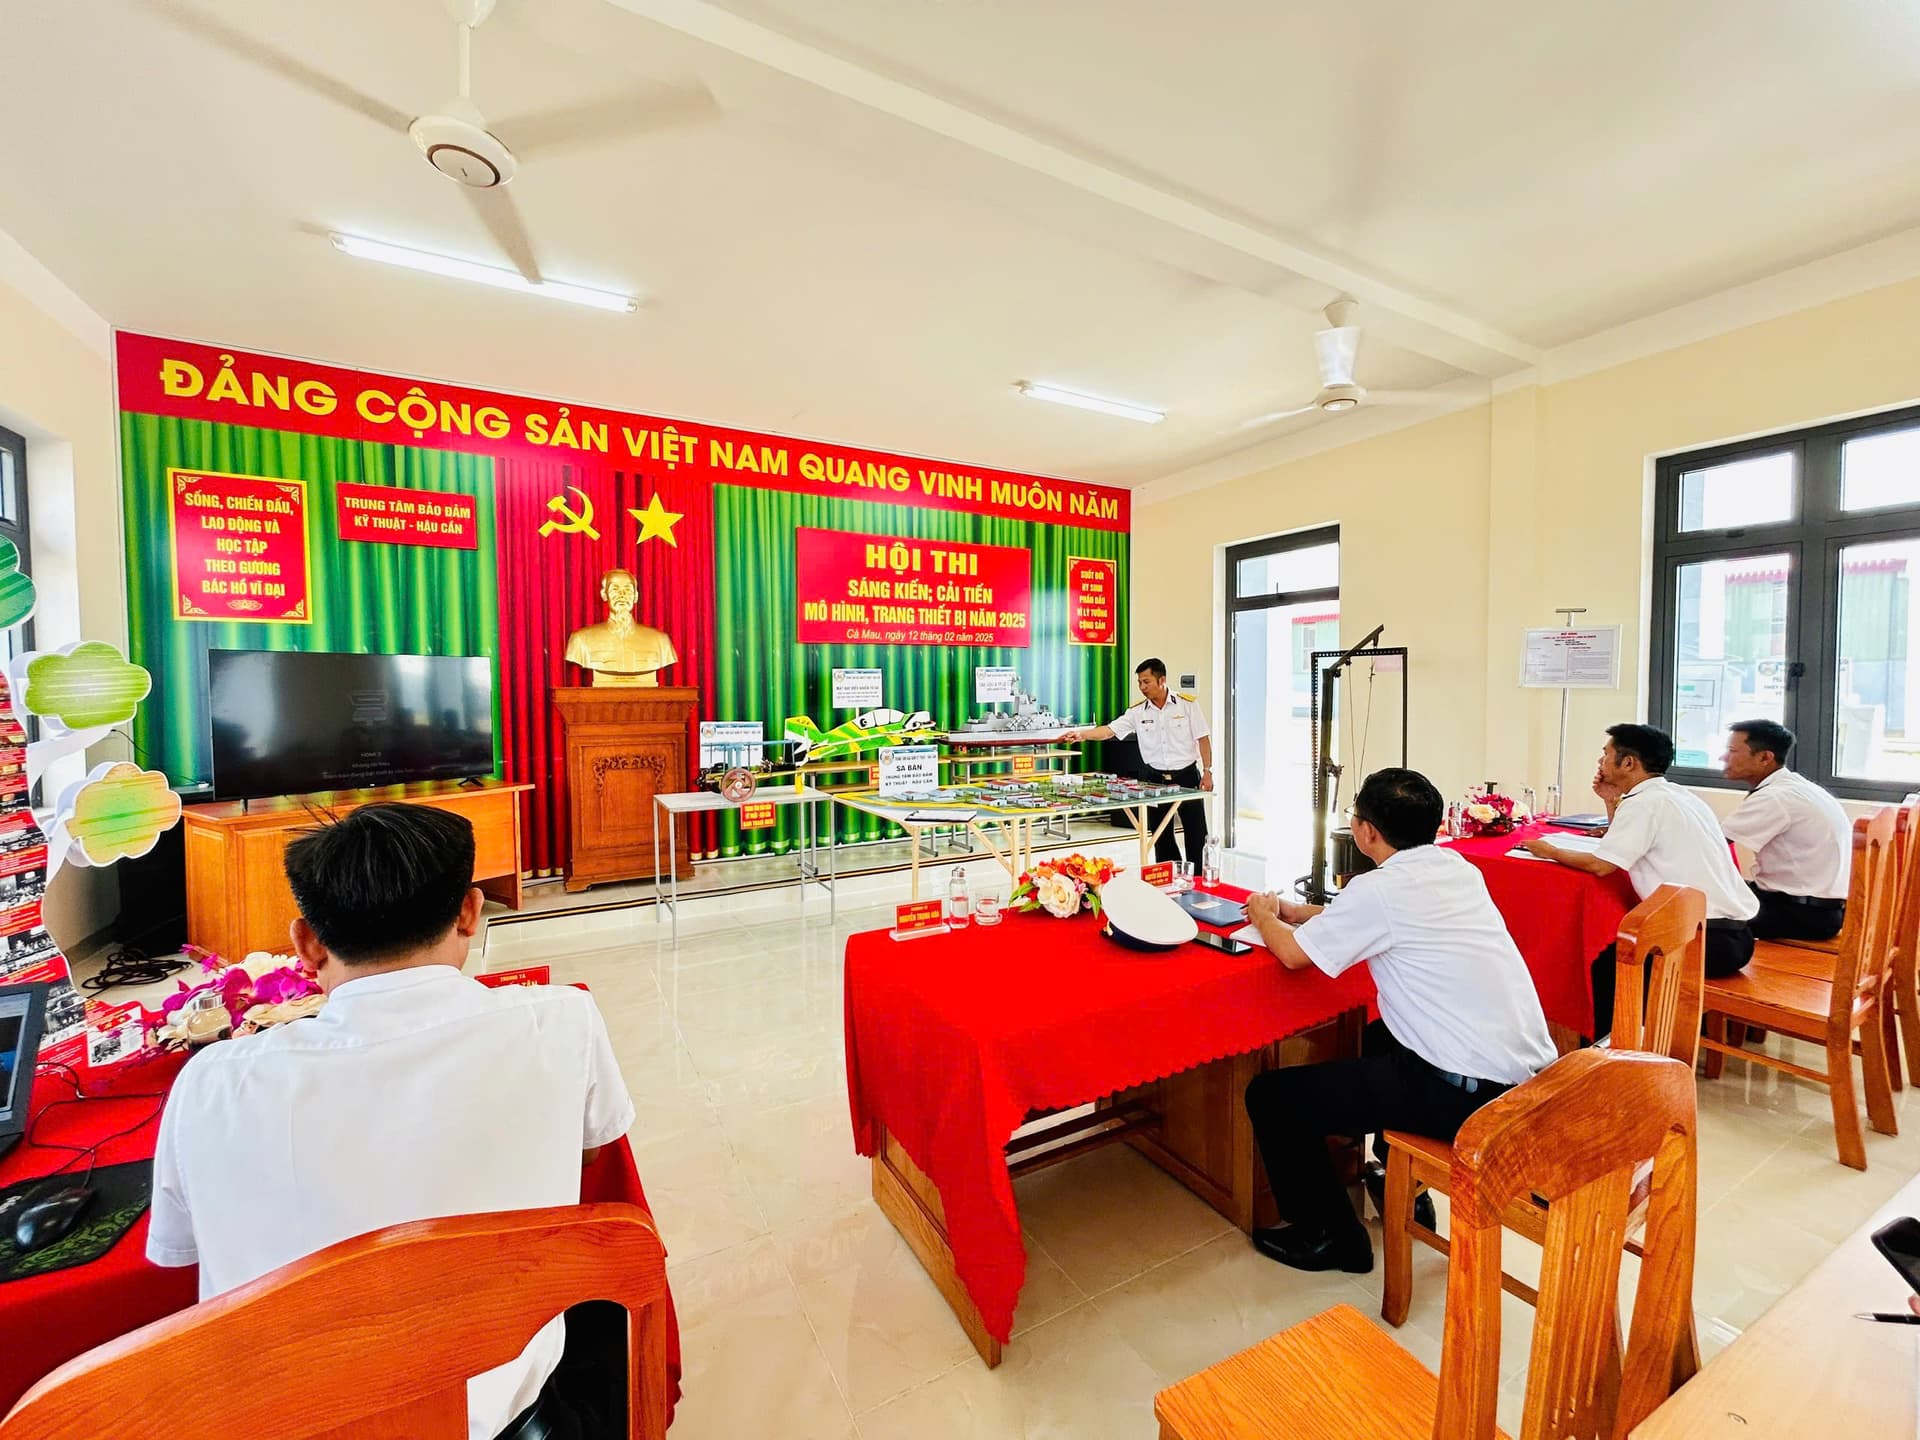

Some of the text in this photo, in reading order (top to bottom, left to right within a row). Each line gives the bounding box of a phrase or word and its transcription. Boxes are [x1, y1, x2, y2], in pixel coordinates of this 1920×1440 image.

[160, 354, 1119, 520] ĐẢNG CỘNG SẢN VIỆT NAM QUANG VINH MUÔN NĂM
[185, 489, 294, 516] SỐNG, CHIẾN ĐẤU,
[344, 497, 471, 519] TRUNG TÂM BẢO ĐẢM
[201, 516, 281, 534] LAO ĐỘNG VÀ
[354, 514, 369, 528] KỸ
[372, 517, 406, 531] THUẬT
[416, 520, 438, 535] HẬU
[216, 538, 268, 557] HỌC TẬP
[204, 559, 281, 576] THEO GƯƠNG
[866, 542, 978, 576] HỘI THI
[201, 578, 227, 594] BÁC
[250, 580, 262, 596] VĨ
[264, 583, 286, 599] ĐẠI
[848, 577, 993, 604] SÁNG KIẾN; CẢI TIẾN
[804, 599, 1026, 630] MÔ HÌNH, TRANG THIẾT BỊ NĂM 2025
[846, 629, 860, 640] Cà
[885, 630, 906, 642] ngày
[909, 630, 919, 640] 12
[920, 631, 943, 643] tháng
[944, 631, 955, 641] 02
[956, 631, 973, 642] năm
[975, 632, 994, 642] 2025
